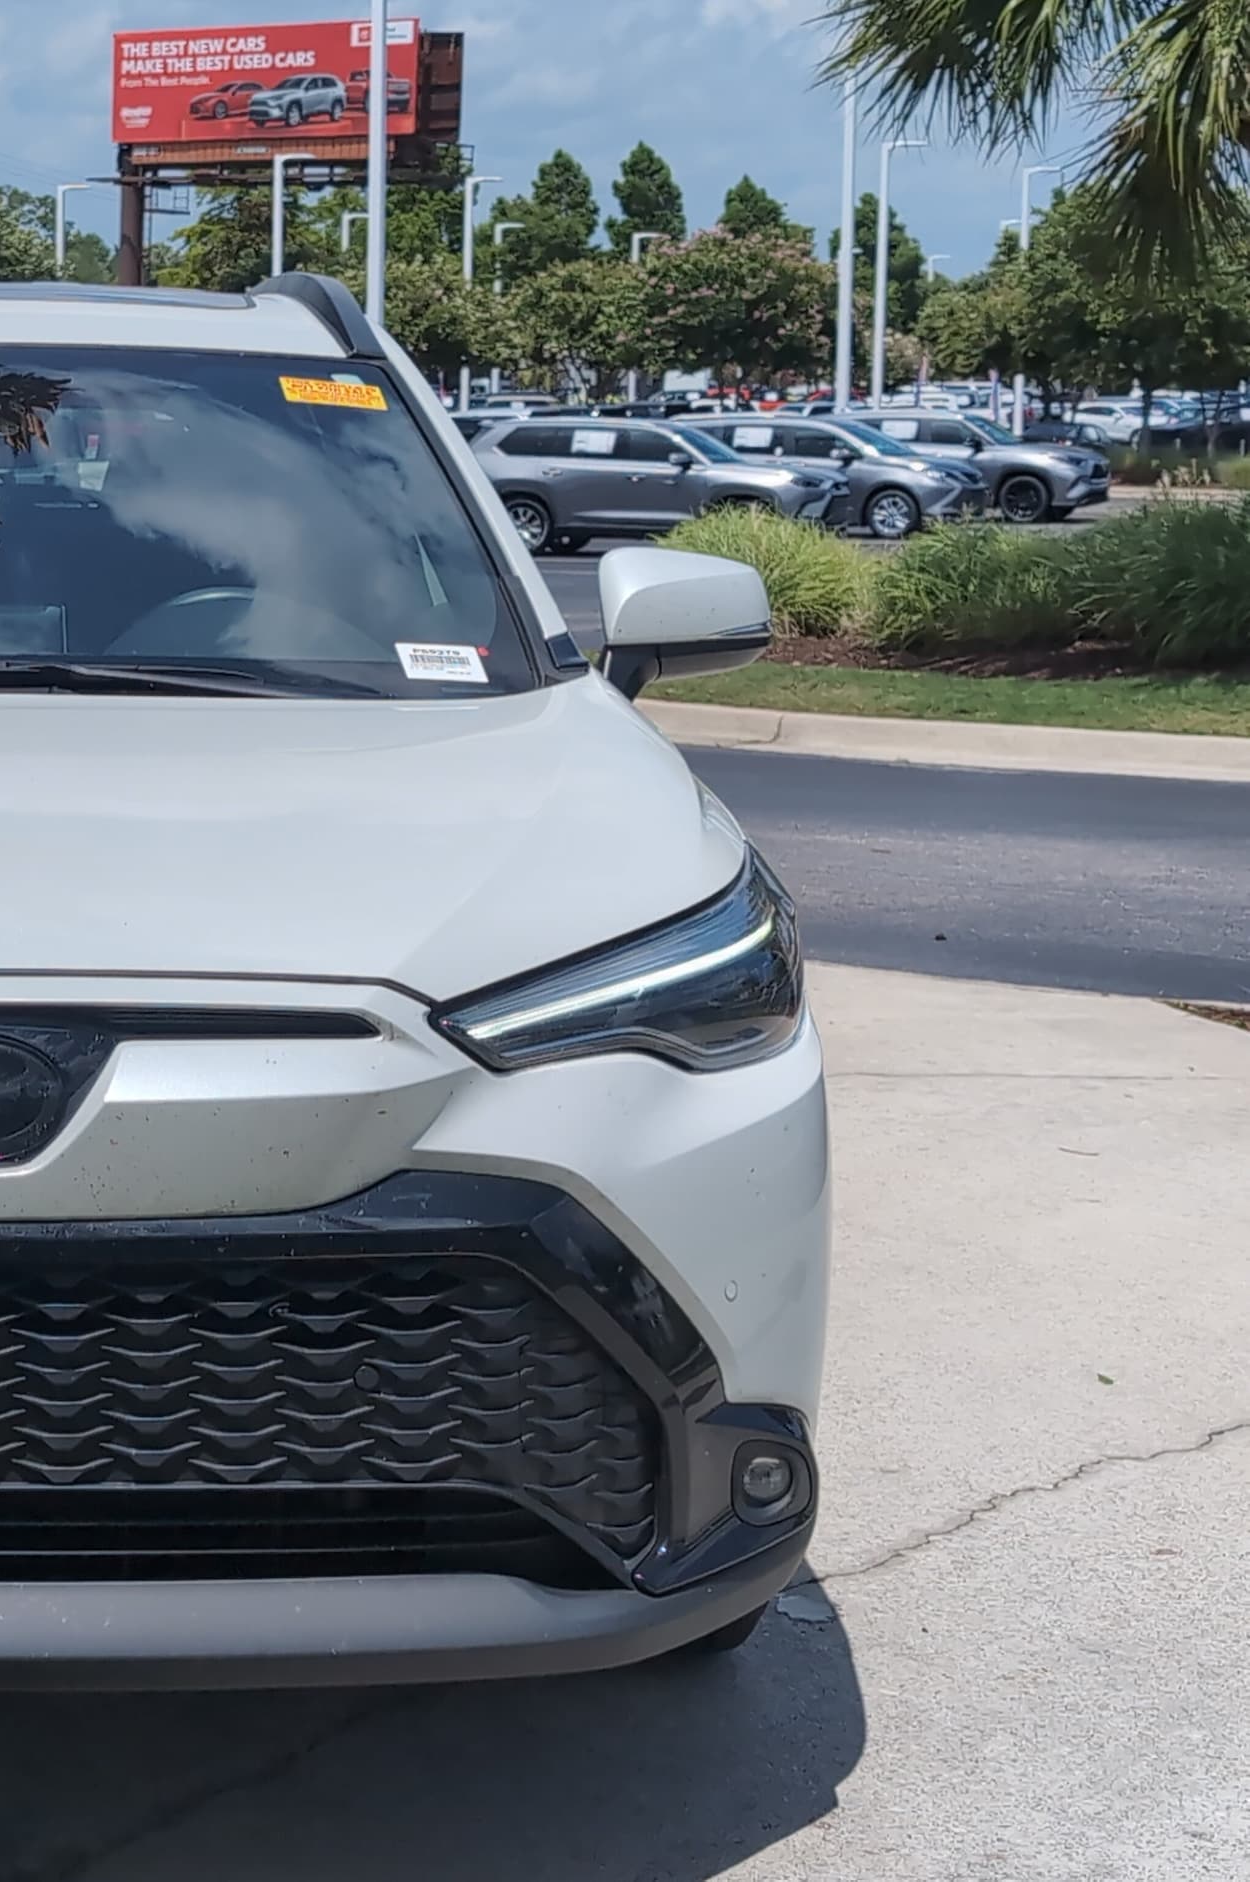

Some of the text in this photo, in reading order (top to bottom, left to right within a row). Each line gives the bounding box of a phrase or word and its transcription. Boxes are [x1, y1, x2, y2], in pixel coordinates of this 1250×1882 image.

[121, 35, 266, 57] THE BEST NEW CARS
[121, 50, 315, 75] MAKE THE BEST USED CARS
[143, 76, 159, 87] The
